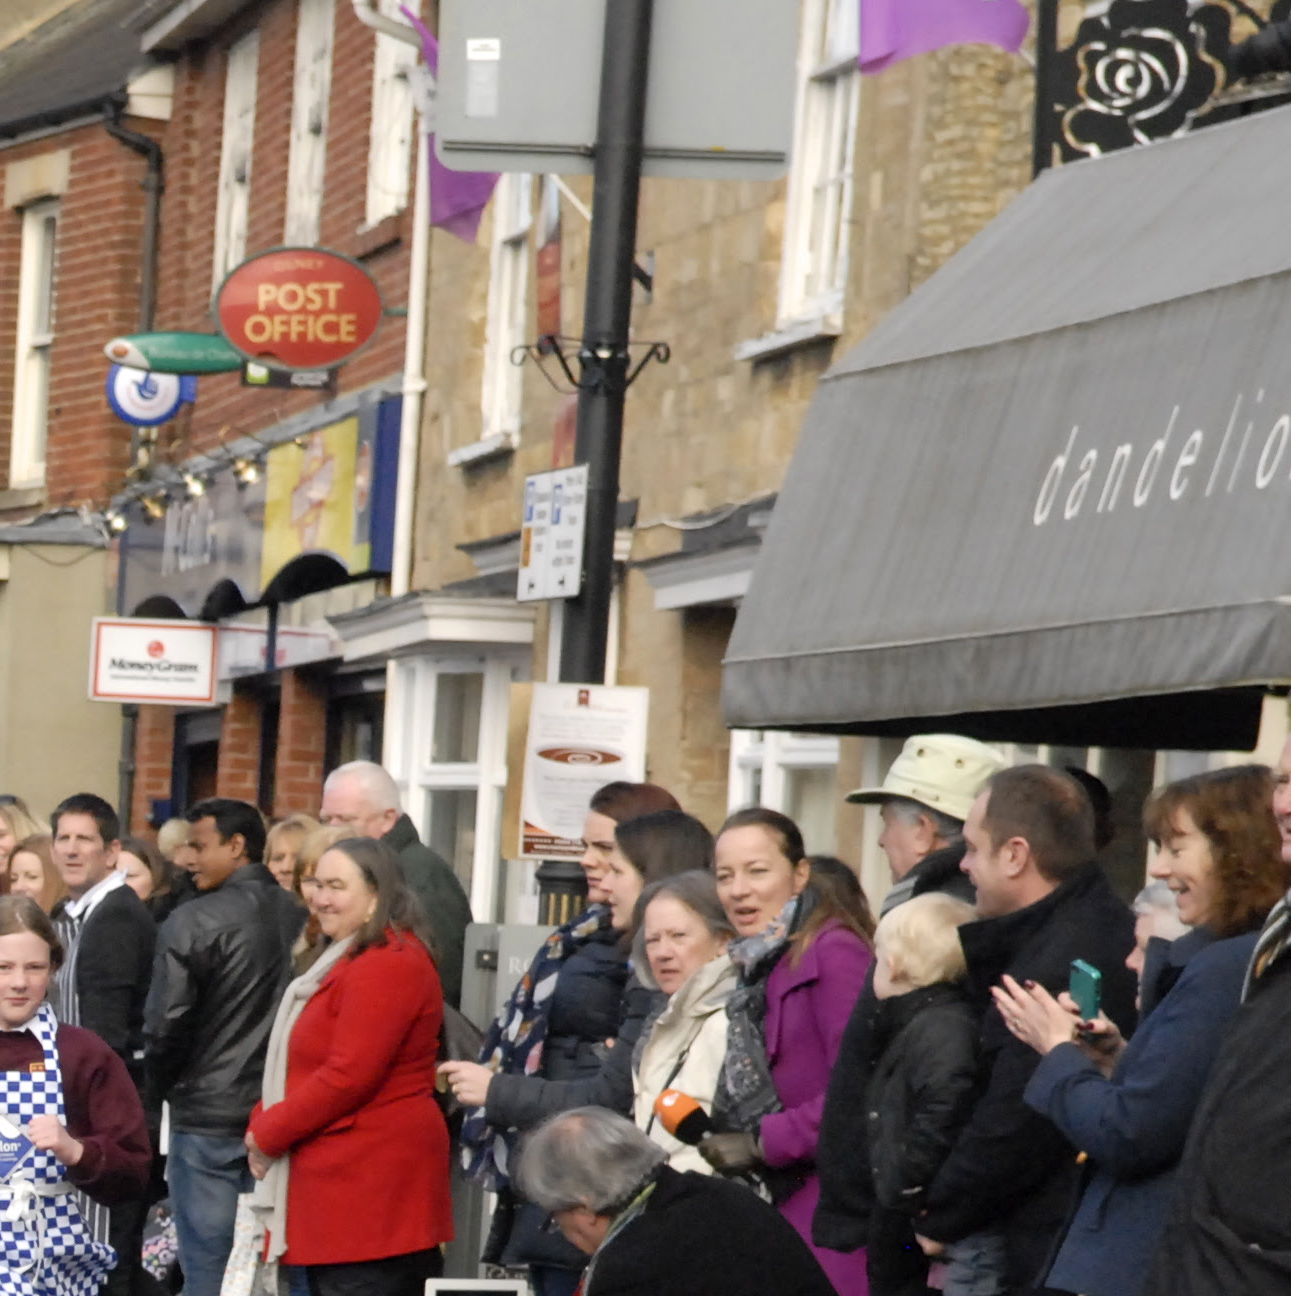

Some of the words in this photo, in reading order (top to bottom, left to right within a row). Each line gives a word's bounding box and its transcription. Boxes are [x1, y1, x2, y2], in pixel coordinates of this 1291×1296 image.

[258, 281, 344, 311] POST
[243, 313, 357, 343] OFFICE
[1033, 388, 1291, 526] dandelio
